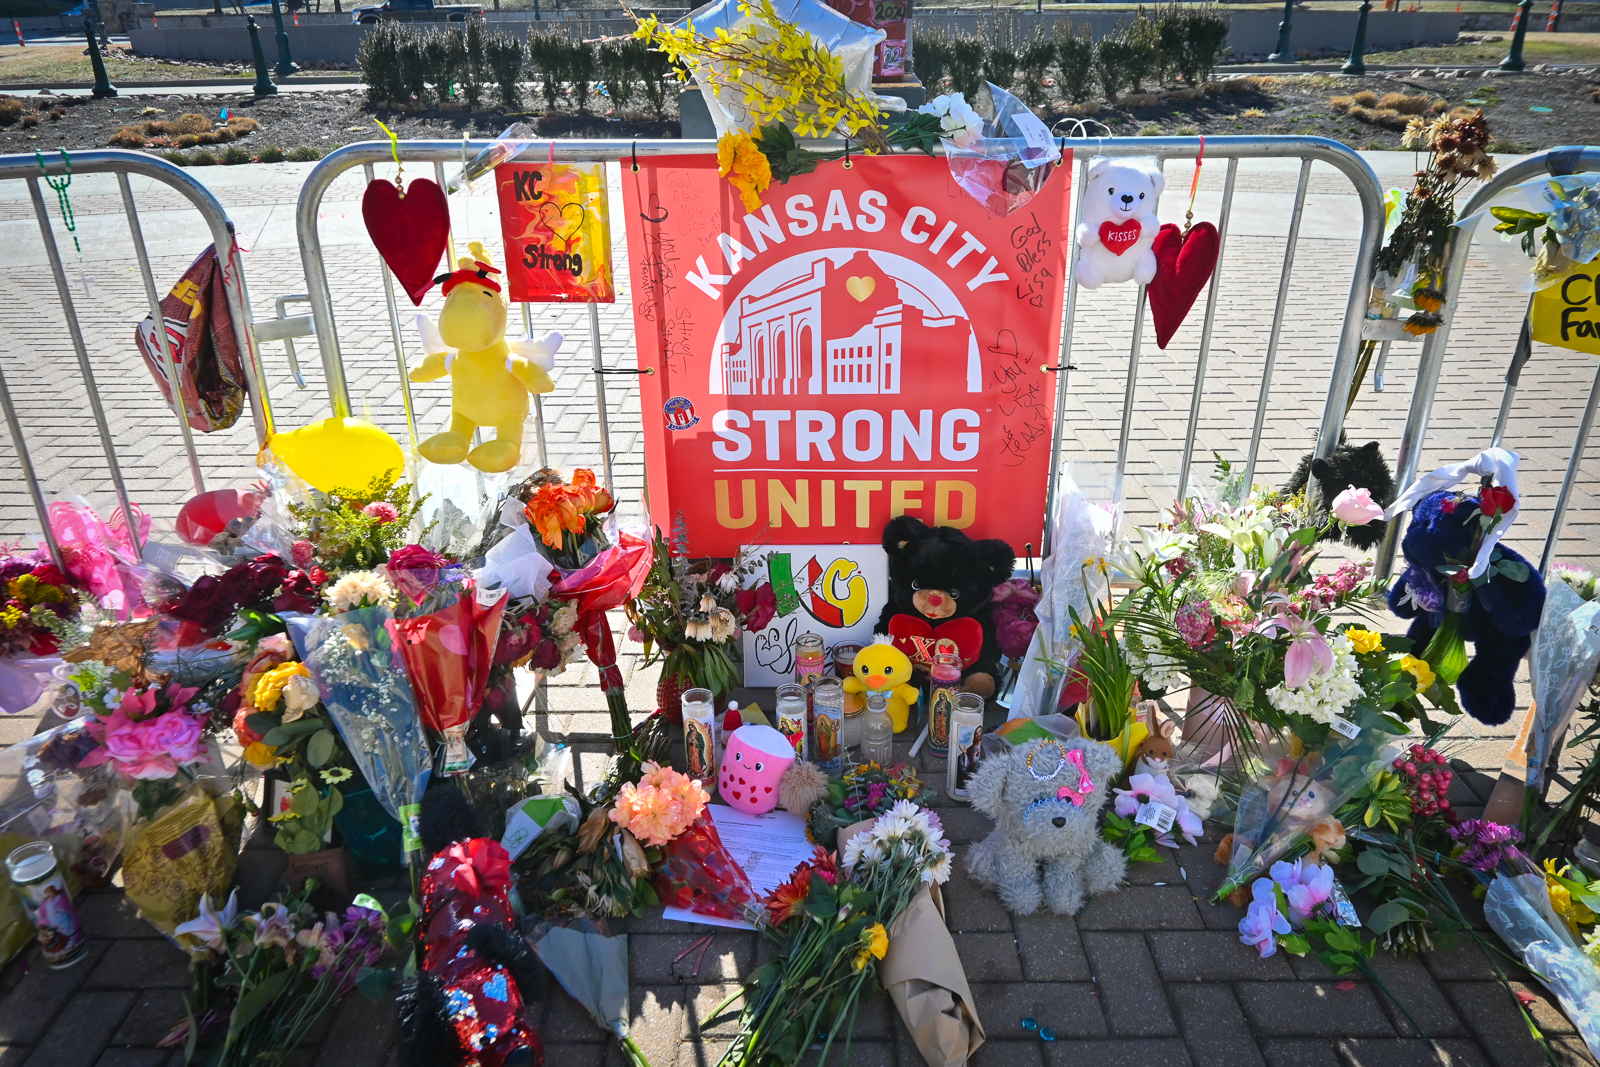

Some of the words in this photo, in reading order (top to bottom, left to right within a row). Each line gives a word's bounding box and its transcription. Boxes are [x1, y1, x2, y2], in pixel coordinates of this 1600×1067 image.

[513, 171, 543, 201] KC
[685, 189, 888, 300] KANSAS
[901, 206, 1009, 291] CITY
[1011, 212, 1042, 249] God
[523, 244, 582, 277] Strong
[1016, 231, 1051, 273] Bless
[711, 408, 981, 462] STRONG
[714, 478, 977, 530] UNITED
